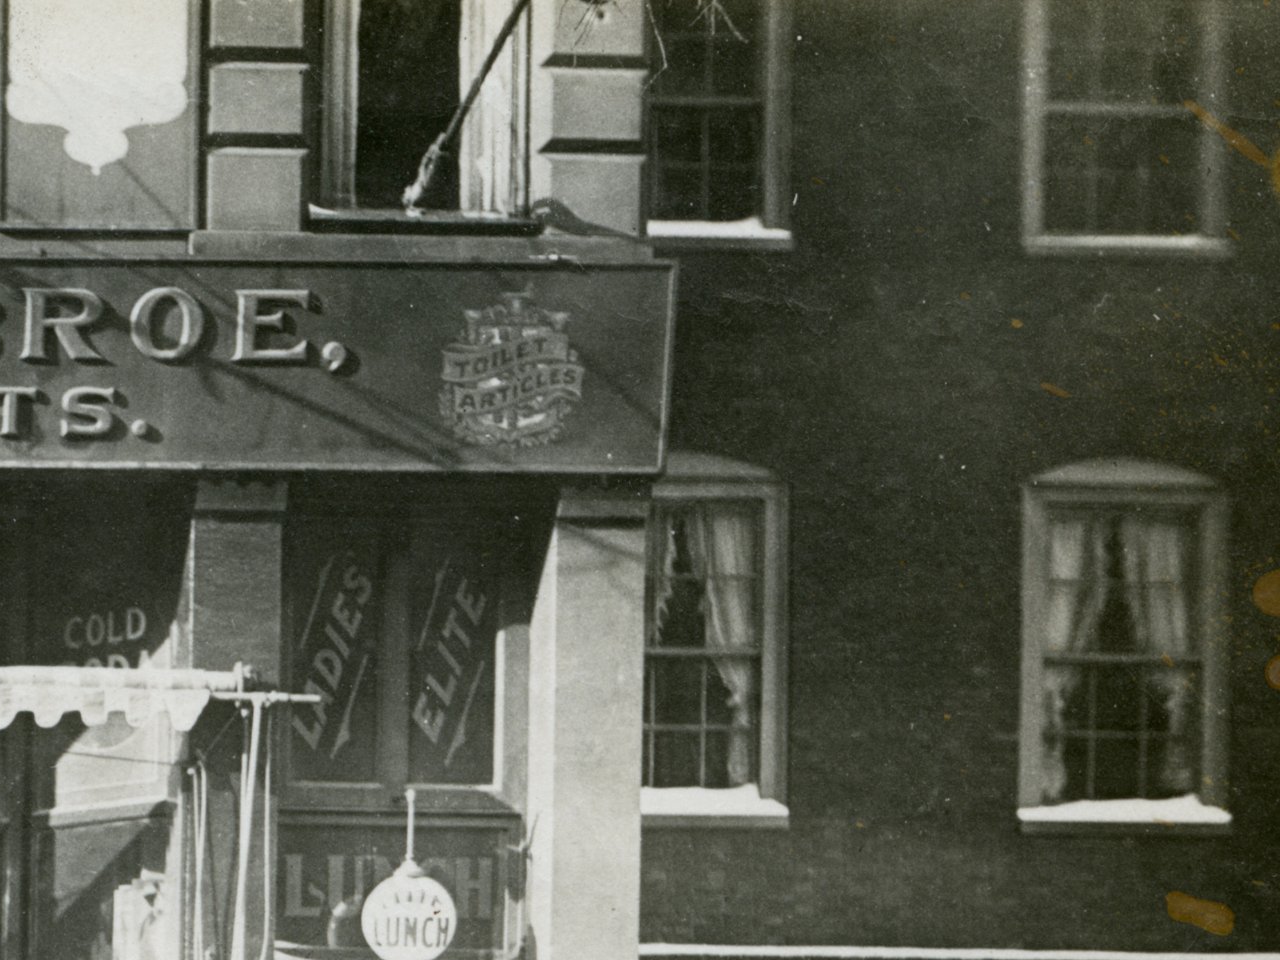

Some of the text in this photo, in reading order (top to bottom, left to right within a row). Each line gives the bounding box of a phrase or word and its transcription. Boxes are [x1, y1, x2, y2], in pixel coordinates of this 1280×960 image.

[454, 338, 548, 378] TOILET
[459, 368, 577, 409] ARTICLES
[64, 606, 147, 650] COLD
[291, 565, 371, 751] LADIES
[412, 578, 487, 744] ELITE
[374, 916, 450, 948] LUNCH
